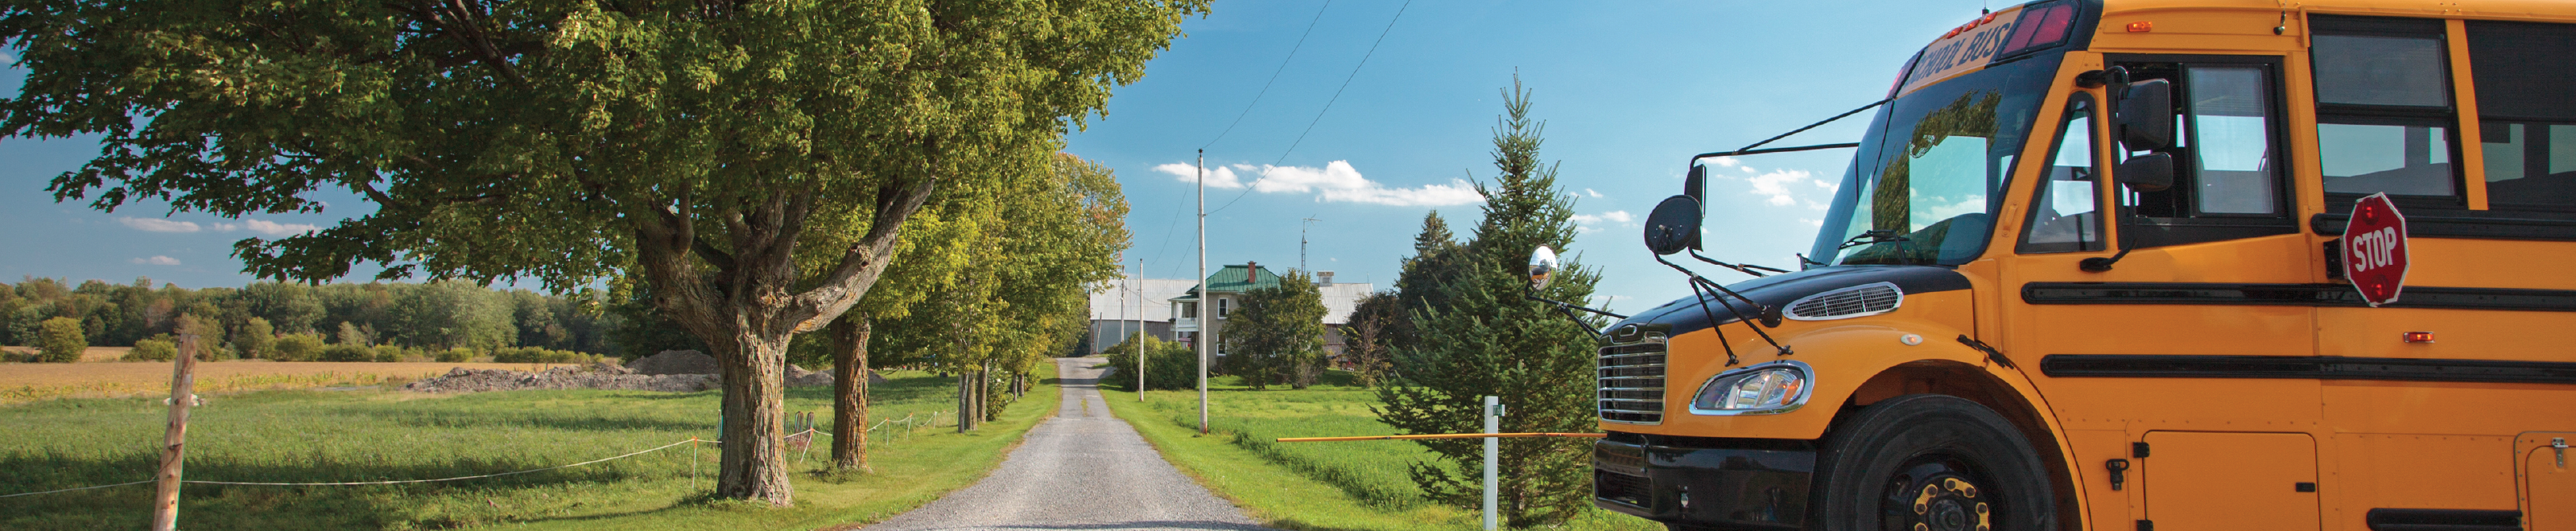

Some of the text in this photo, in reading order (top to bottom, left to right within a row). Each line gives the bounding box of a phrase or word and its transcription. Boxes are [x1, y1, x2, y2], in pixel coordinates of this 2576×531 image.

[1904, 23, 2011, 88] SCHOOL BUS
[2352, 226, 2396, 272] STOP
